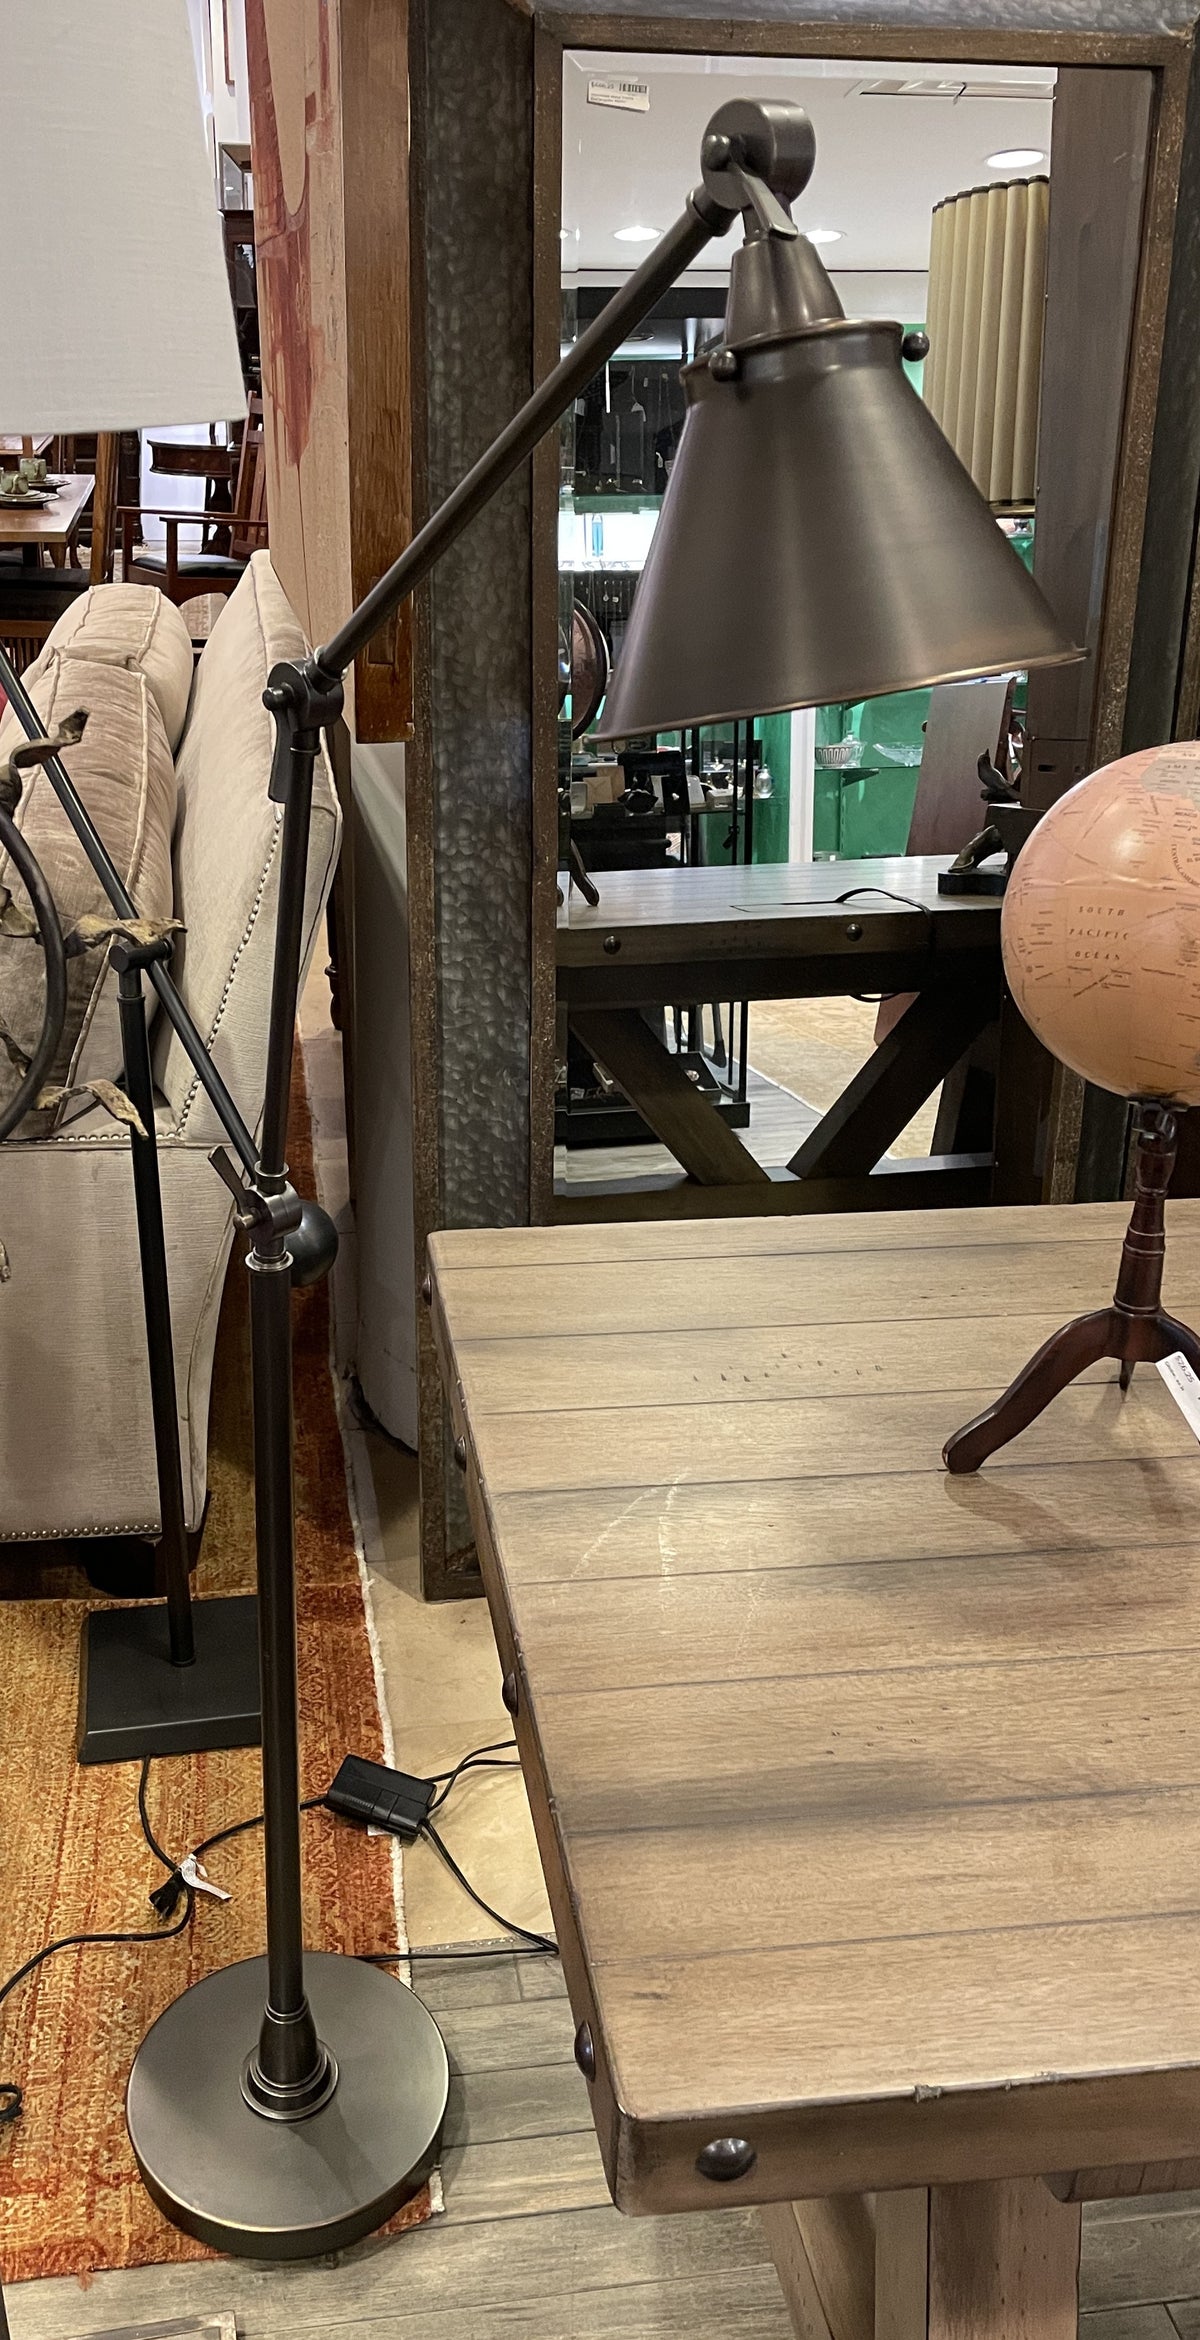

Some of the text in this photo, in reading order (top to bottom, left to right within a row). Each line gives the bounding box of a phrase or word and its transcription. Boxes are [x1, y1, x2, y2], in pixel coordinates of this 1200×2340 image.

[1079, 906, 1125, 916] SOUTH
[1069, 928, 1128, 940] PACIFIC
[1075, 951, 1120, 960] OCEAN
